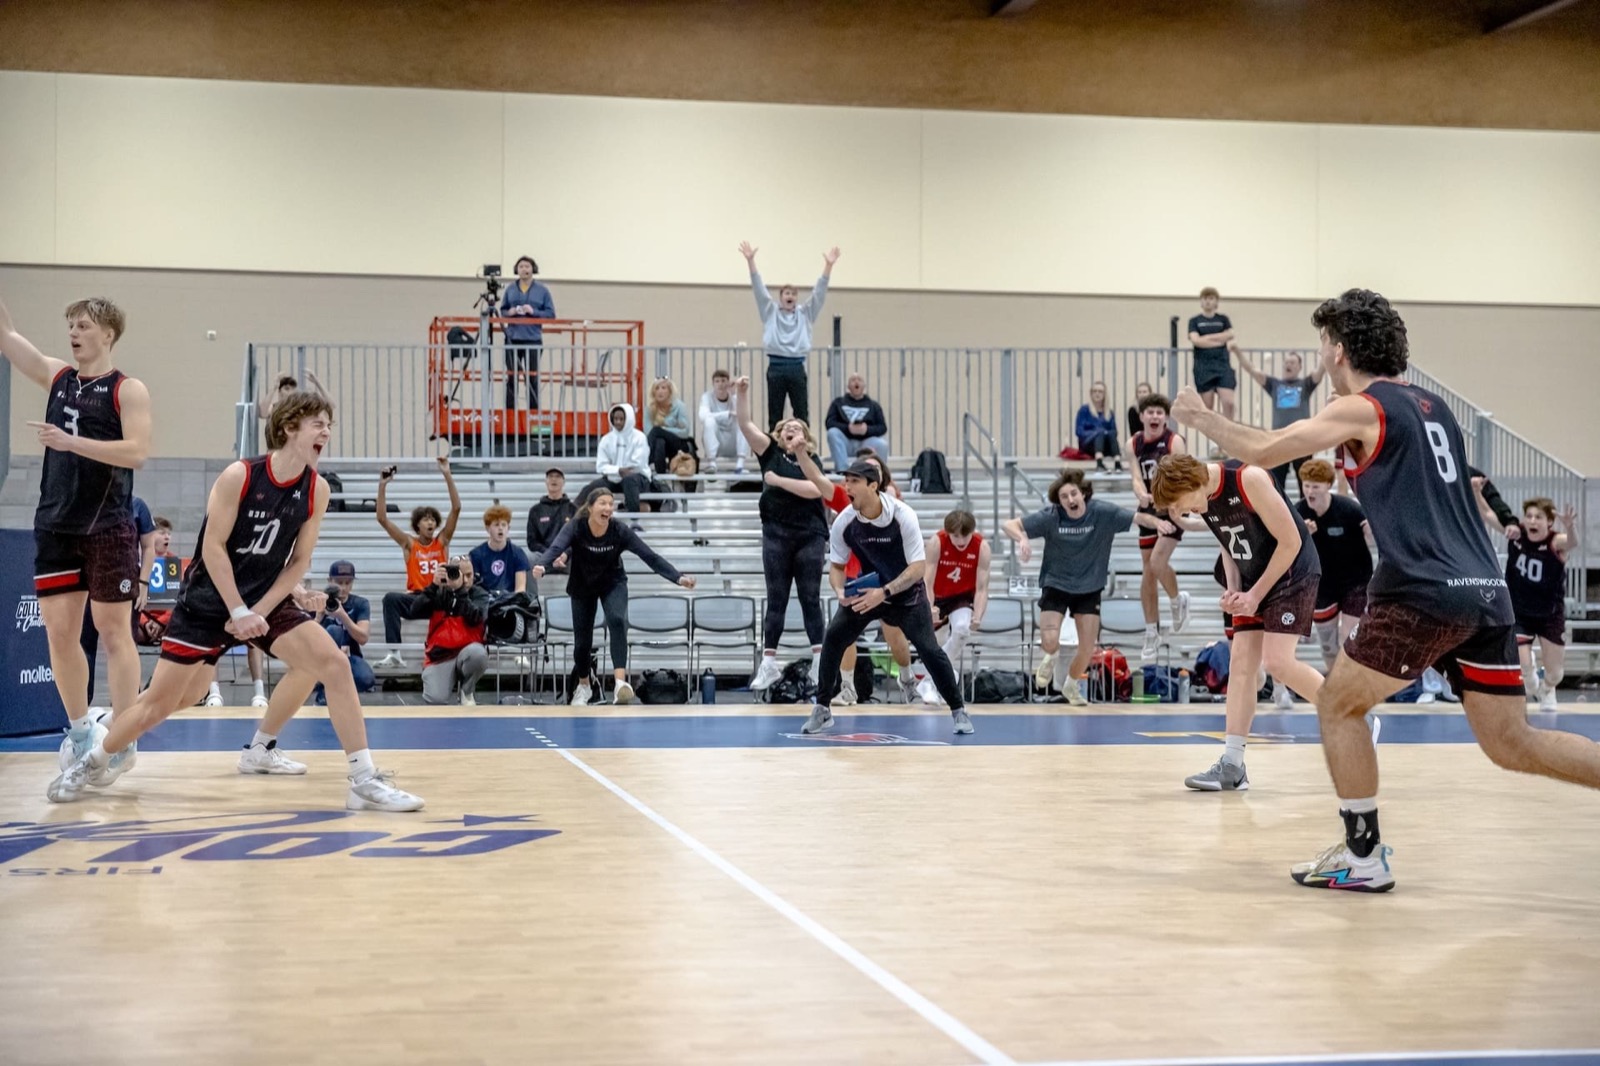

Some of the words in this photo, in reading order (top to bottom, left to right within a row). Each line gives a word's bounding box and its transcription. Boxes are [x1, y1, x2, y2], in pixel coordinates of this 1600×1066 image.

[1424, 421, 1457, 483] 8
[1220, 524, 1252, 560] 25
[151, 562, 163, 588] 3
[169, 563, 177, 576] 3
[419, 559, 438, 575] 33
[946, 567, 961, 583] 4
[1515, 553, 1543, 582] 40
[0, 866, 163, 875] FIRS
